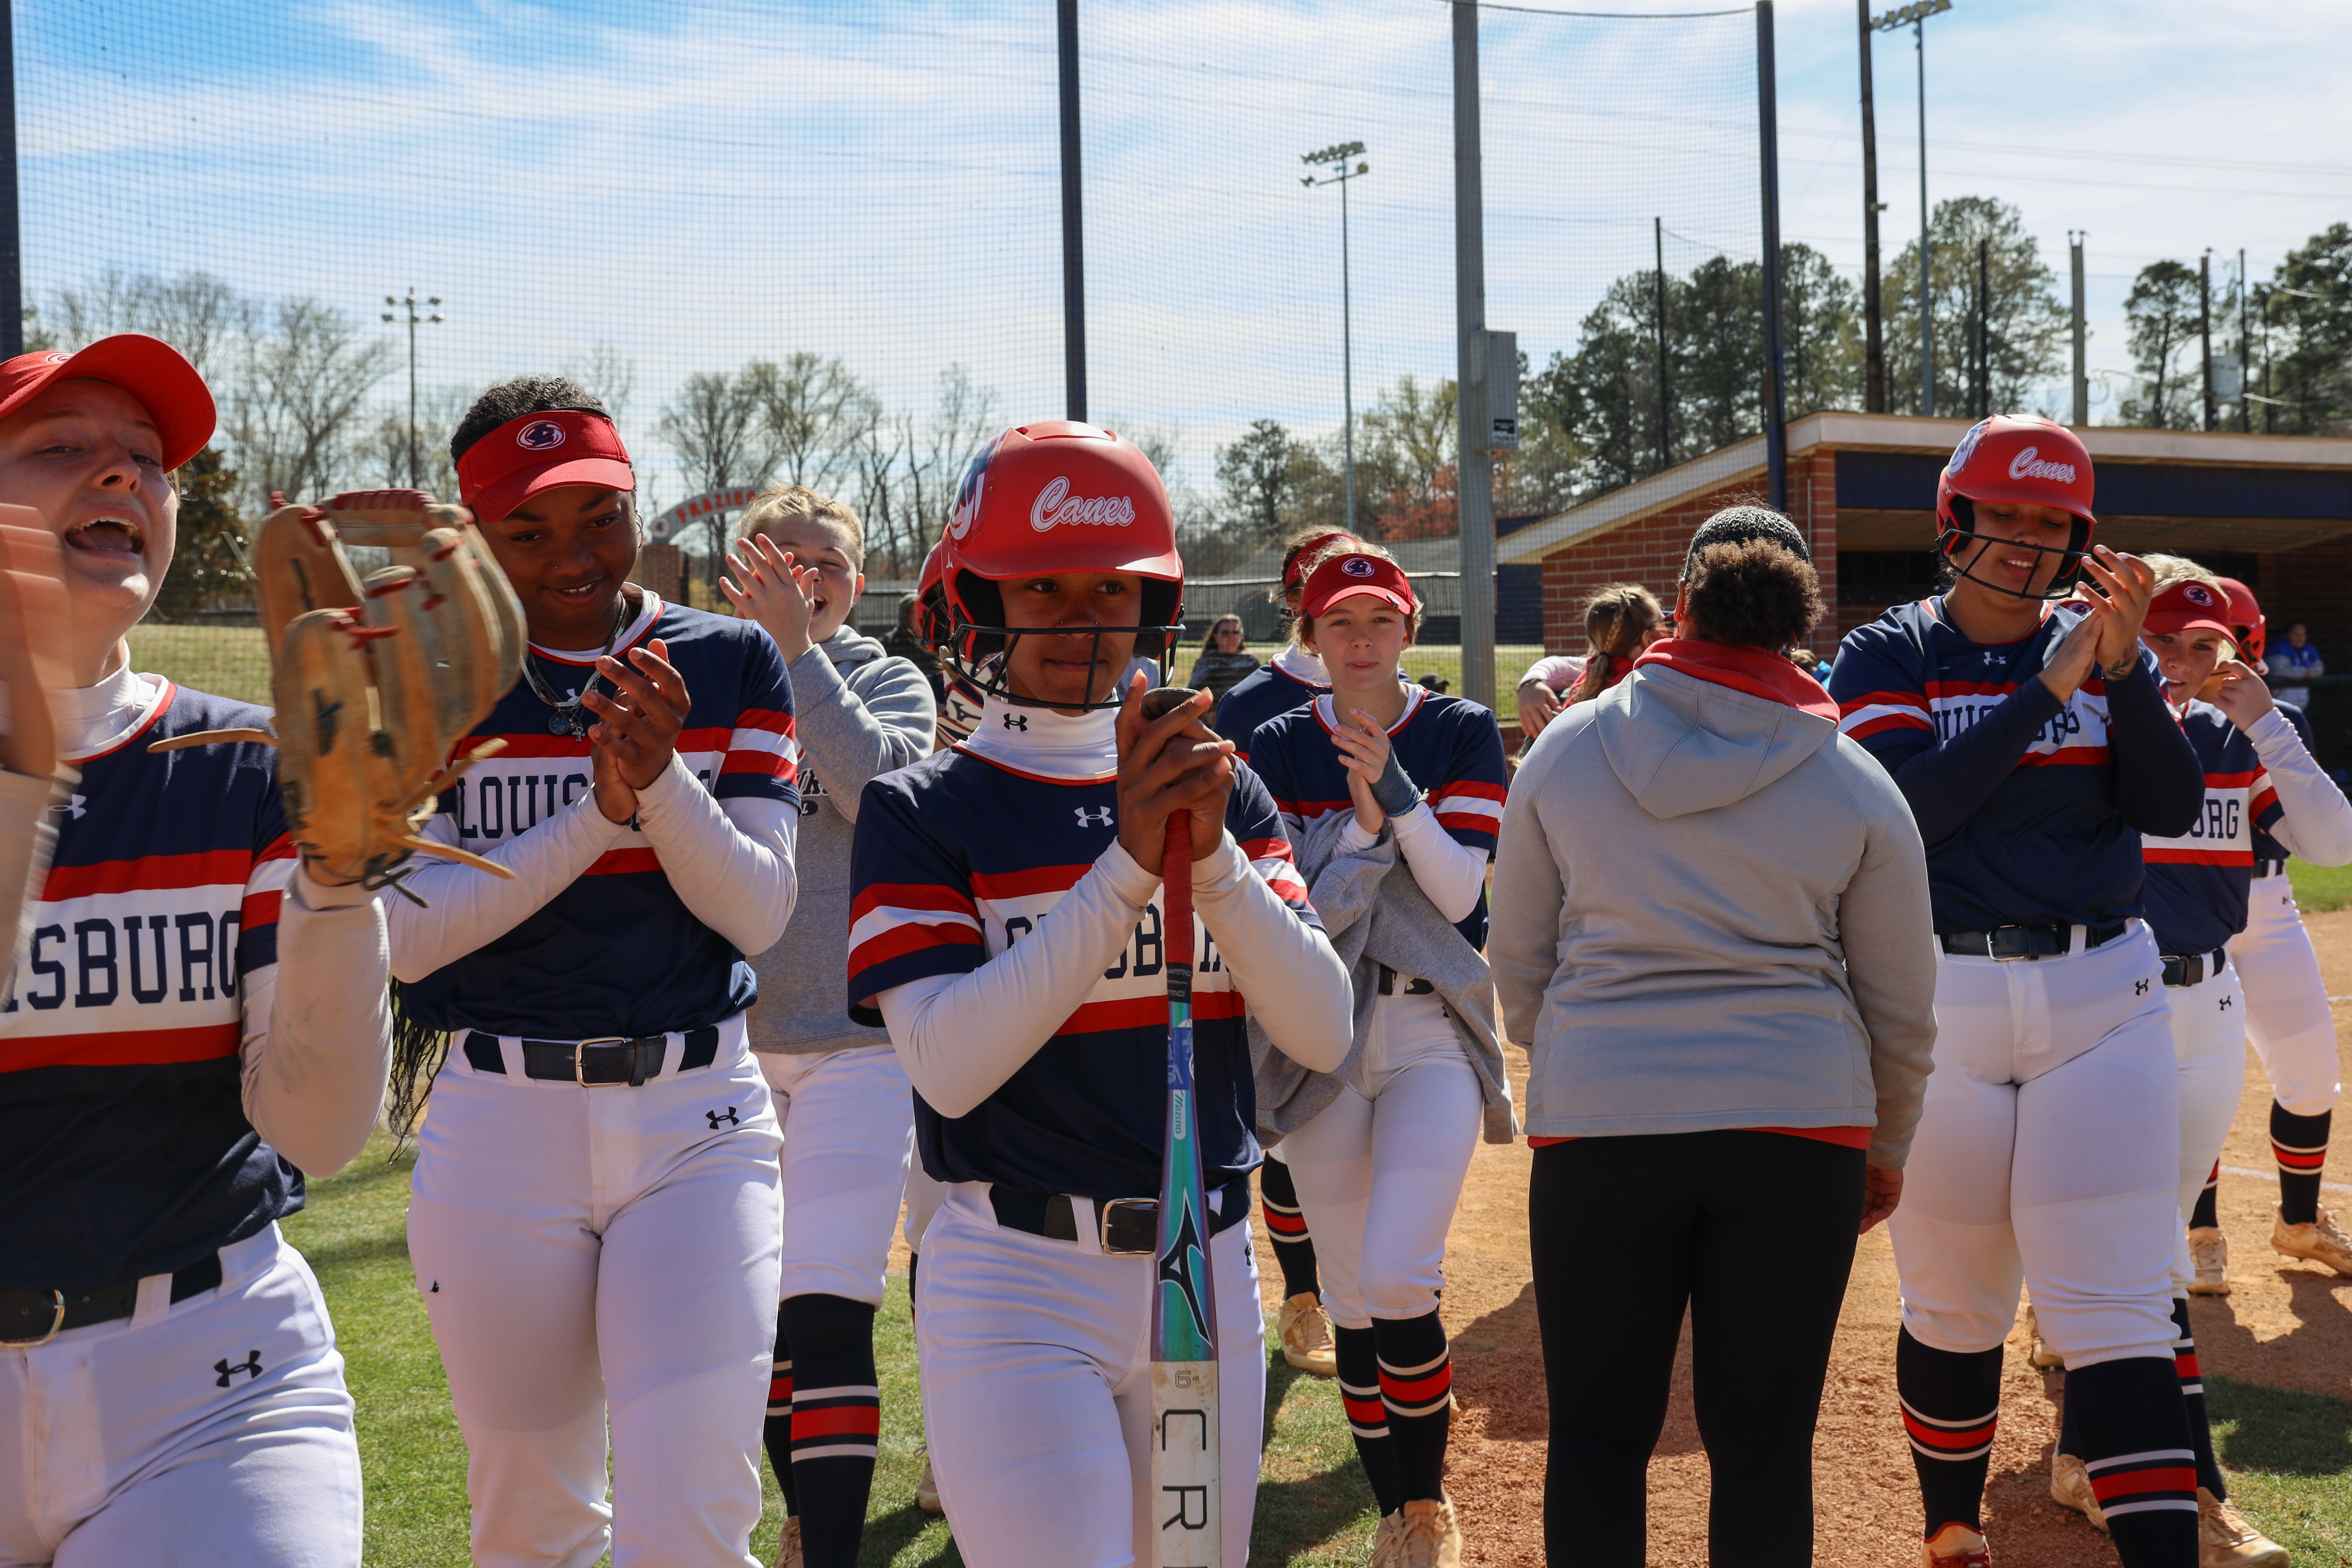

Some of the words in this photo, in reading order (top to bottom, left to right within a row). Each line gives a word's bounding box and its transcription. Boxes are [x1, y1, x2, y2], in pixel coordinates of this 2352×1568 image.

[2009, 446, 2075, 484] Canes
[1030, 476, 1135, 532] Canes
[1162, 1409, 1208, 1568] CR
